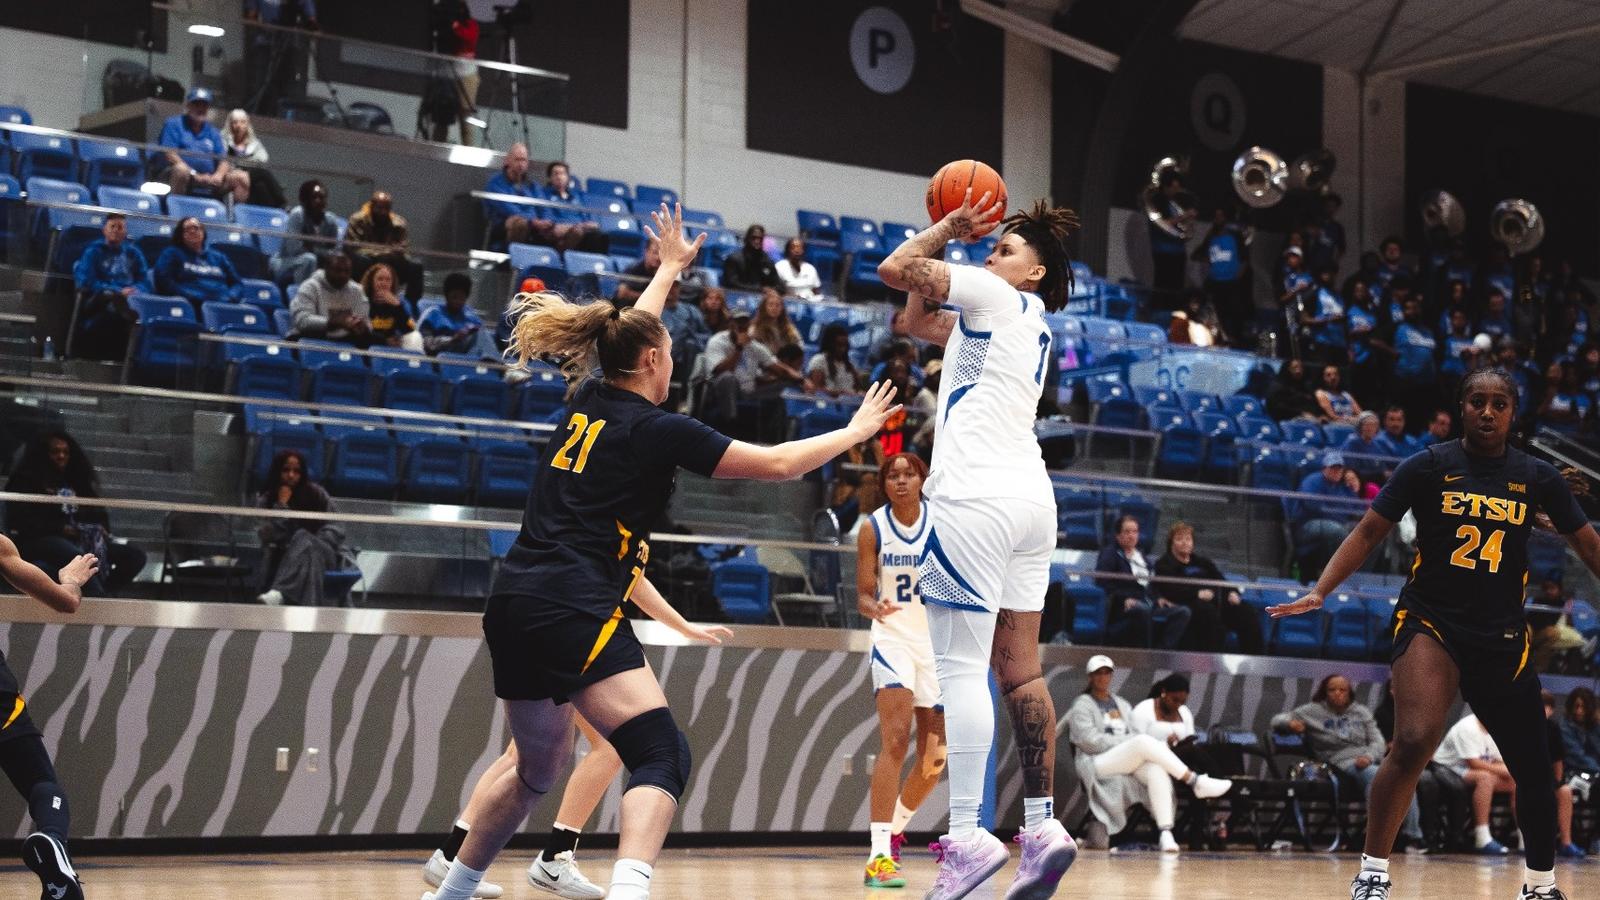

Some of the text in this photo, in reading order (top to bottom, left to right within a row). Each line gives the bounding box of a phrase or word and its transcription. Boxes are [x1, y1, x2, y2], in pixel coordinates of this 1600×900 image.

[868, 28, 896, 69] P
[1203, 92, 1233, 134] Q
[550, 412, 607, 474] 21
[1441, 491, 1527, 525] ETSU
[882, 553, 921, 568] Memp
[1449, 524, 1506, 573] 24
